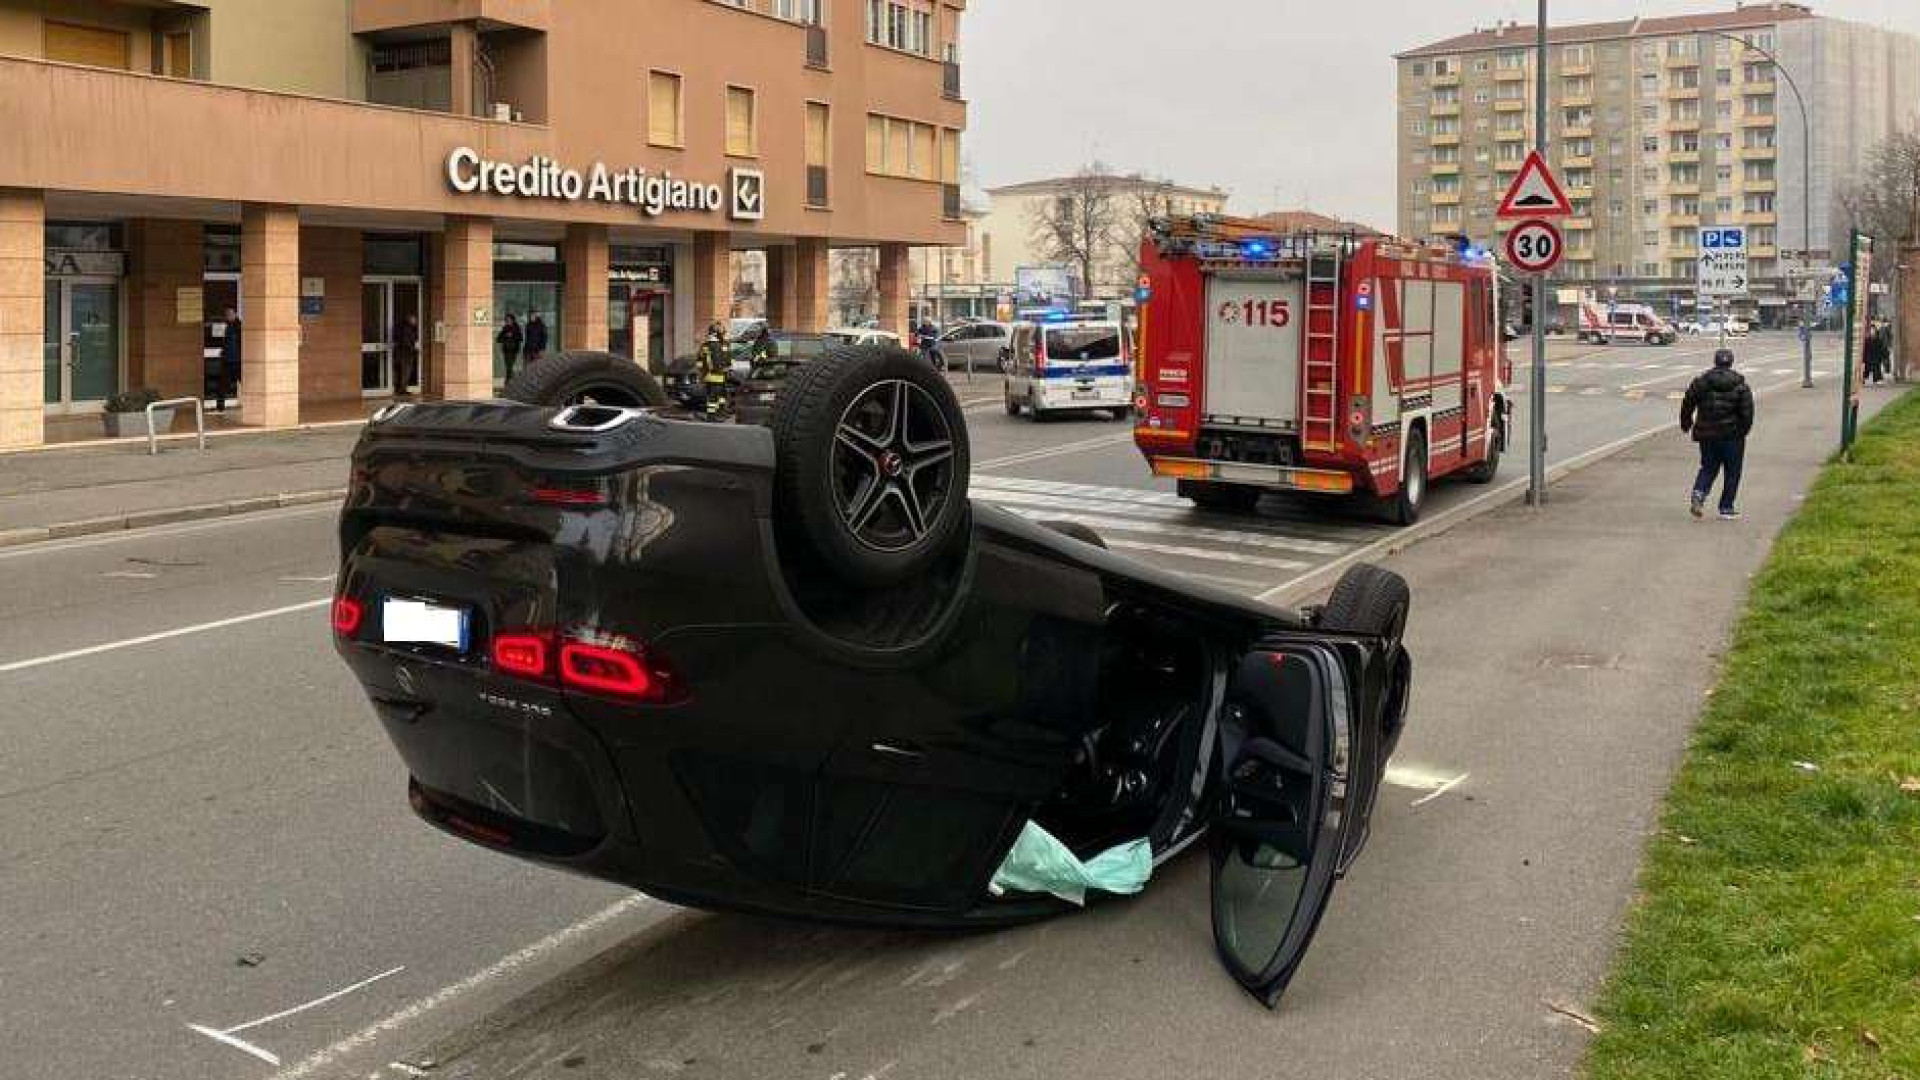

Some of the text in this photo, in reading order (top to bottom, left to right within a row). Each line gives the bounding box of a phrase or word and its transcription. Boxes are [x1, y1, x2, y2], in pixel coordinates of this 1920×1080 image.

[449, 147, 721, 215] Credito Artigiano
[1519, 234, 1551, 258] 30
[1706, 232, 1719, 246] P
[1243, 299, 1290, 327] 115
